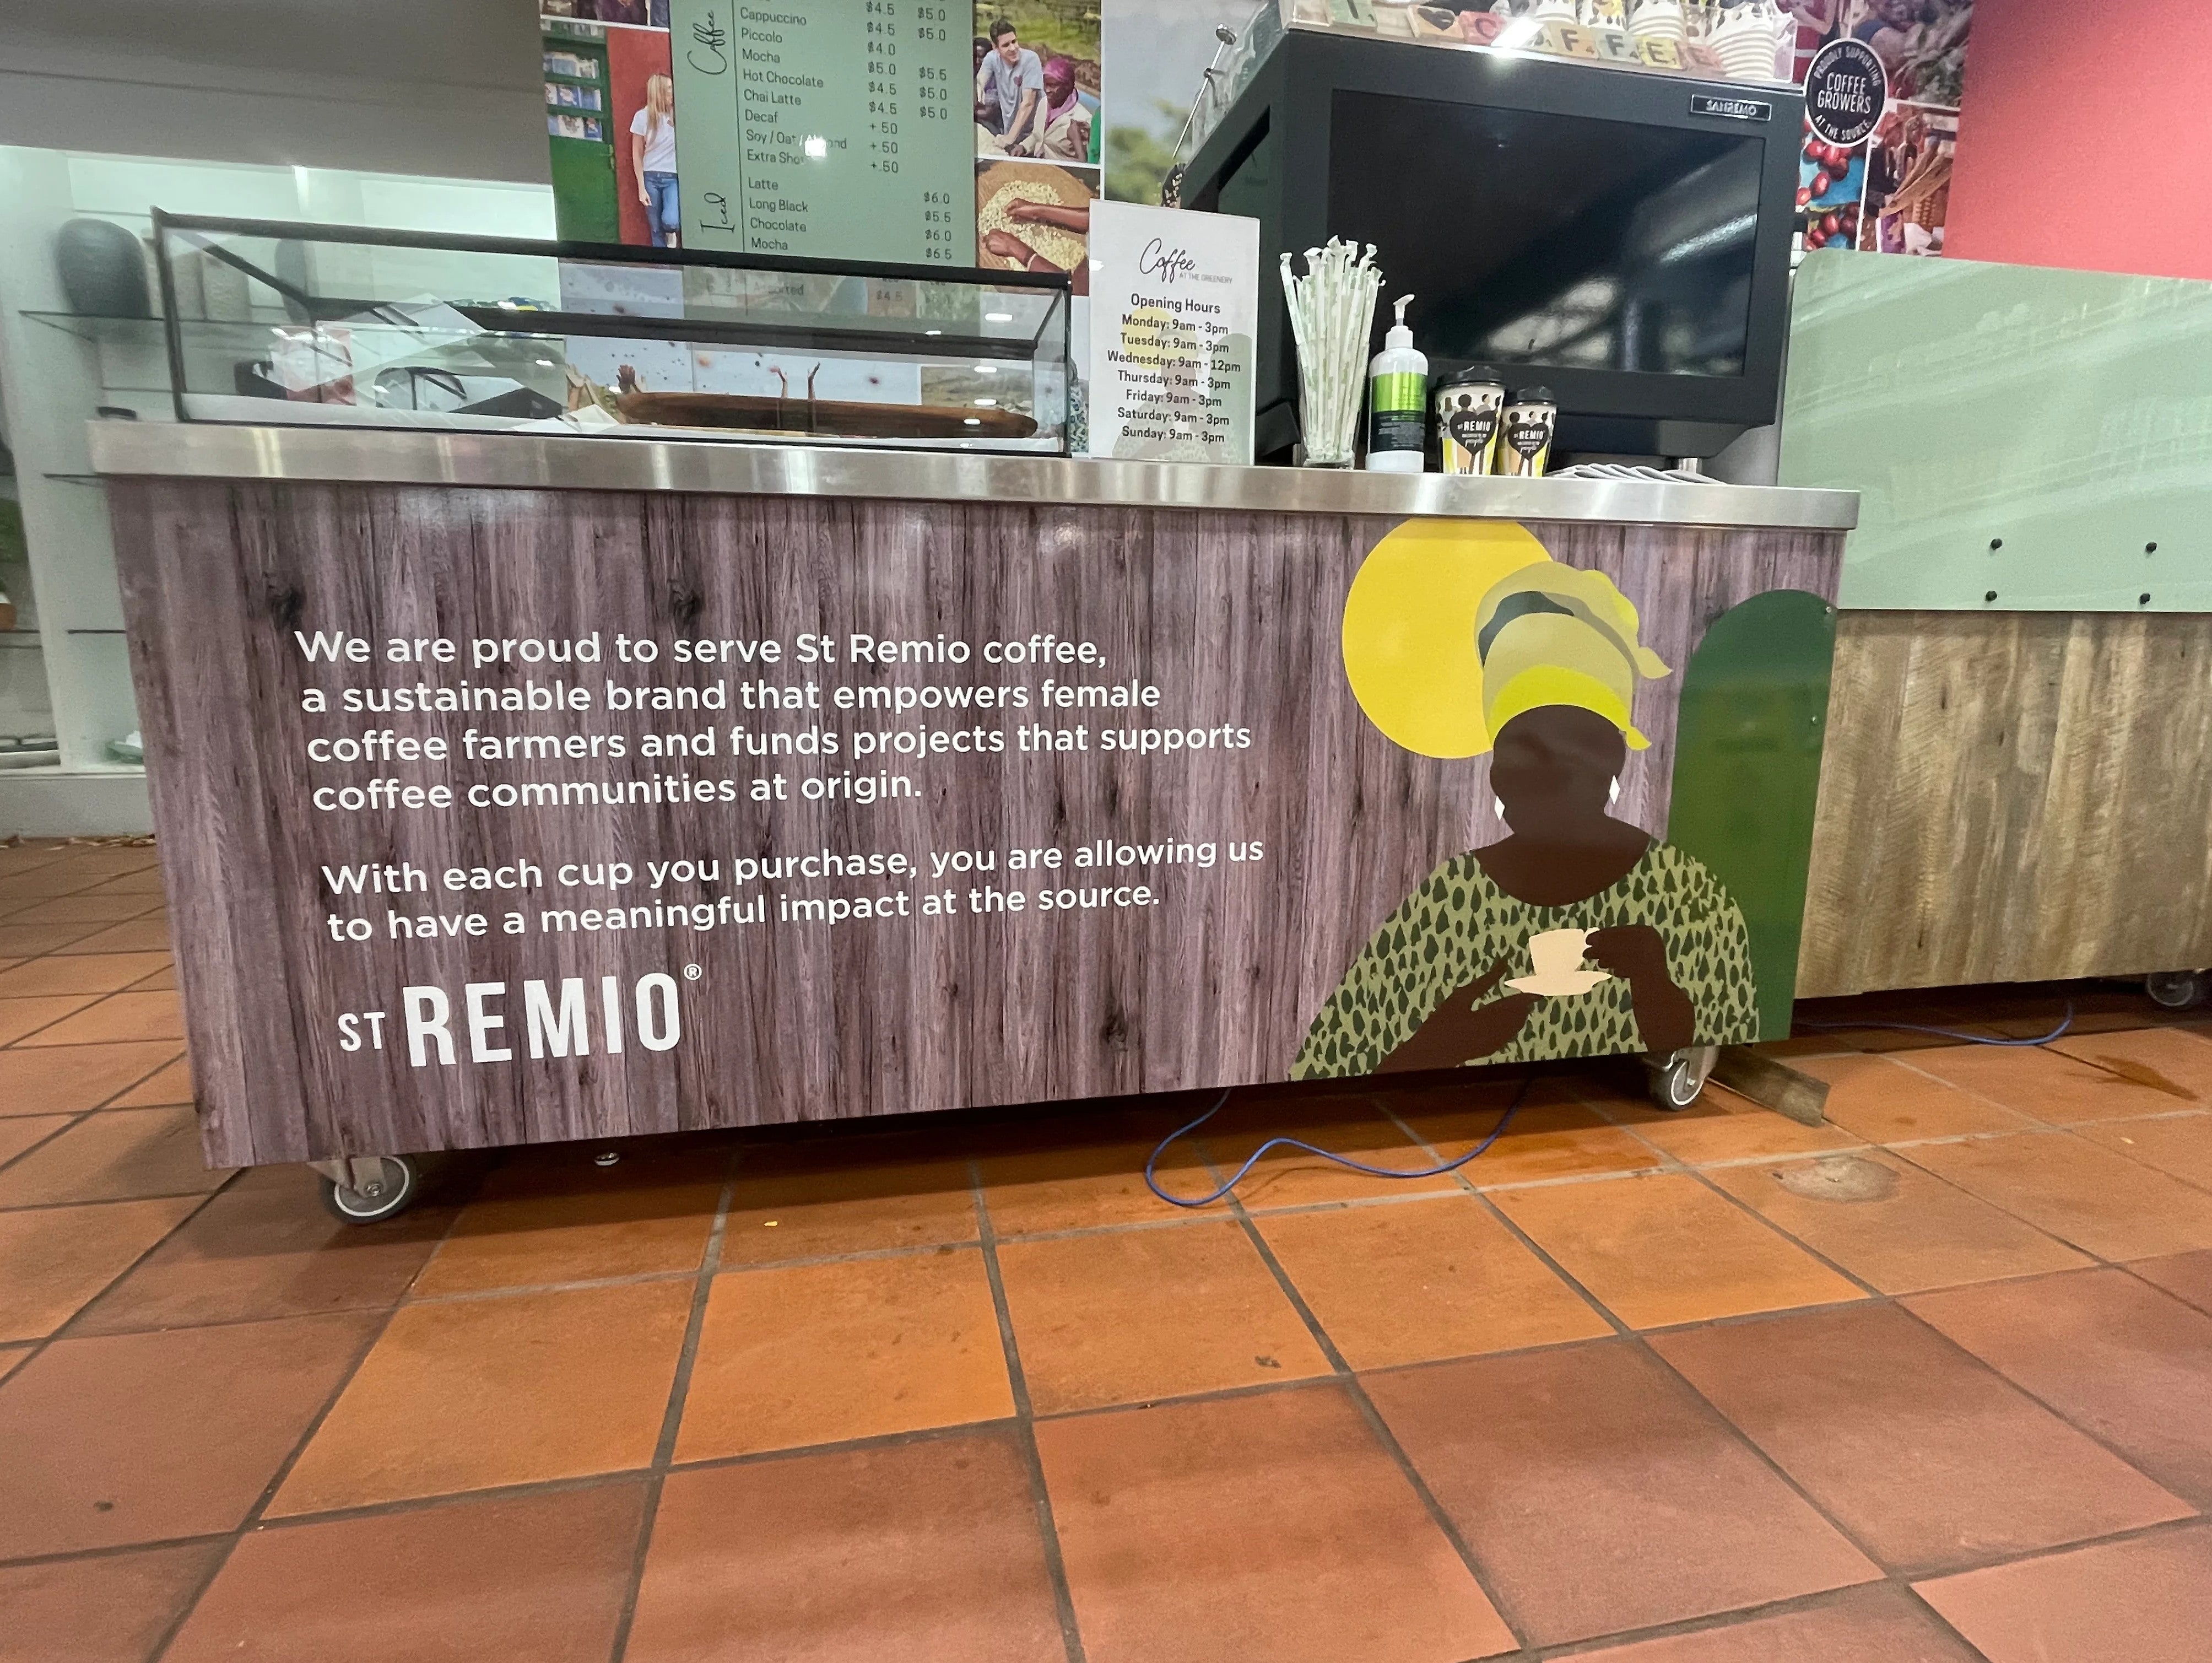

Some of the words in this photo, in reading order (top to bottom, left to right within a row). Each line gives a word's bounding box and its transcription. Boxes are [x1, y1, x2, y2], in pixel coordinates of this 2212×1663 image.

[740, 7, 807, 26] Cappuccino
[687, 9, 727, 75] Coffee
[742, 28, 782, 43] Piccolo
[742, 48, 780, 63] Mocha
[743, 68, 764, 83] Hot
[766, 71, 824, 88] Chocolate
[1827, 72, 1867, 96] COFFEE
[744, 89, 769, 103] Chai
[771, 90, 802, 105] Latte
[1817, 89, 1872, 114] GROWERS
[745, 109, 778, 123] Decaf
[1706, 99, 1757, 116] SANREMO
[1815, 115, 1826, 127] AT
[746, 129, 767, 144] Soy
[747, 149, 776, 163] Extra
[748, 176, 778, 191] Latte
[699, 192, 735, 234] Iced
[749, 197, 776, 213] Long
[779, 199, 808, 213] Black
[750, 217, 807, 232] Chocolate
[751, 237, 788, 251] Mocha
[1139, 237, 1196, 283] Coffee
[1131, 293, 1182, 312] Opening
[1186, 298, 1221, 314] Hours
[1122, 314, 1169, 331] Monday:
[1172, 319, 1196, 331] 9am
[1205, 322, 1229, 335] 3pm
[1120, 332, 1170, 349] Tuesday:
[1173, 338, 1197, 350] 9am
[1205, 341, 1229, 354] 3pm
[1107, 350, 1176, 369] Wednesday:
[1178, 357, 1202, 369] 9am
[1210, 359, 1241, 372] 12pm
[1117, 370, 1172, 386] Thursday:
[1175, 375, 1198, 387] 9am
[1208, 377, 1231, 390] 3pm
[1126, 389, 1163, 403] Friday:
[1166, 392, 1189, 404] 9am
[1198, 395, 1222, 408] 3pm
[1117, 407, 1171, 423] Saturday:
[1174, 411, 1197, 423] 9am
[1207, 413, 1229, 426] 3pm
[1463, 421, 1491, 431] REMIO
[1122, 426, 1166, 441] Sunday:
[1169, 429, 1192, 440] 9am
[1201, 431, 1225, 444] 3pm
[1519, 430, 1544, 440] REMIO
[294, 631, 370, 662] We
[387, 638, 456, 662] are
[472, 631, 601, 668] proud
[615, 634, 658, 662] to
[674, 639, 781, 663] serve
[797, 633, 835, 663] St
[850, 634, 970, 663] Remio
[983, 634, 1106, 668] coffee,
[302, 689, 326, 712] a
[343, 679, 591, 712] sustainable
[607, 679, 726, 710] brand
[740, 679, 820, 709] that
[834, 686, 1029, 714] empowers
[1041, 679, 1160, 708] female
[307, 730, 447, 762] coffee
[462, 728, 626, 759] farmers
[641, 726, 715, 757] and
[729, 723, 839, 755] funds
[854, 724, 1005, 760] projects
[1017, 723, 1089, 752] that
[1100, 723, 1251, 755] supports
[313, 778, 452, 811] coffee
[468, 773, 736, 807] communities
[750, 774, 787, 801] at
[801, 769, 921, 804] origin.
[321, 862, 428, 895] With
[443, 859, 543, 890] each
[558, 862, 633, 890] cup
[647, 860, 719, 889] you
[735, 848, 917, 886] purchase,
[930, 850, 994, 878] you
[1008, 847, 1062, 870] are
[1074, 838, 1216, 868] allowing
[1229, 841, 1263, 862] us
[327, 914, 372, 941] to
[388, 910, 488, 939] have
[503, 913, 525, 934] a
[541, 894, 765, 932] meaningful
[780, 890, 910, 925] impact
[922, 889, 956, 915] at
[969, 885, 1026, 914] the
[1038, 886, 1159, 910] source.
[338, 1012, 386, 1051] ST
